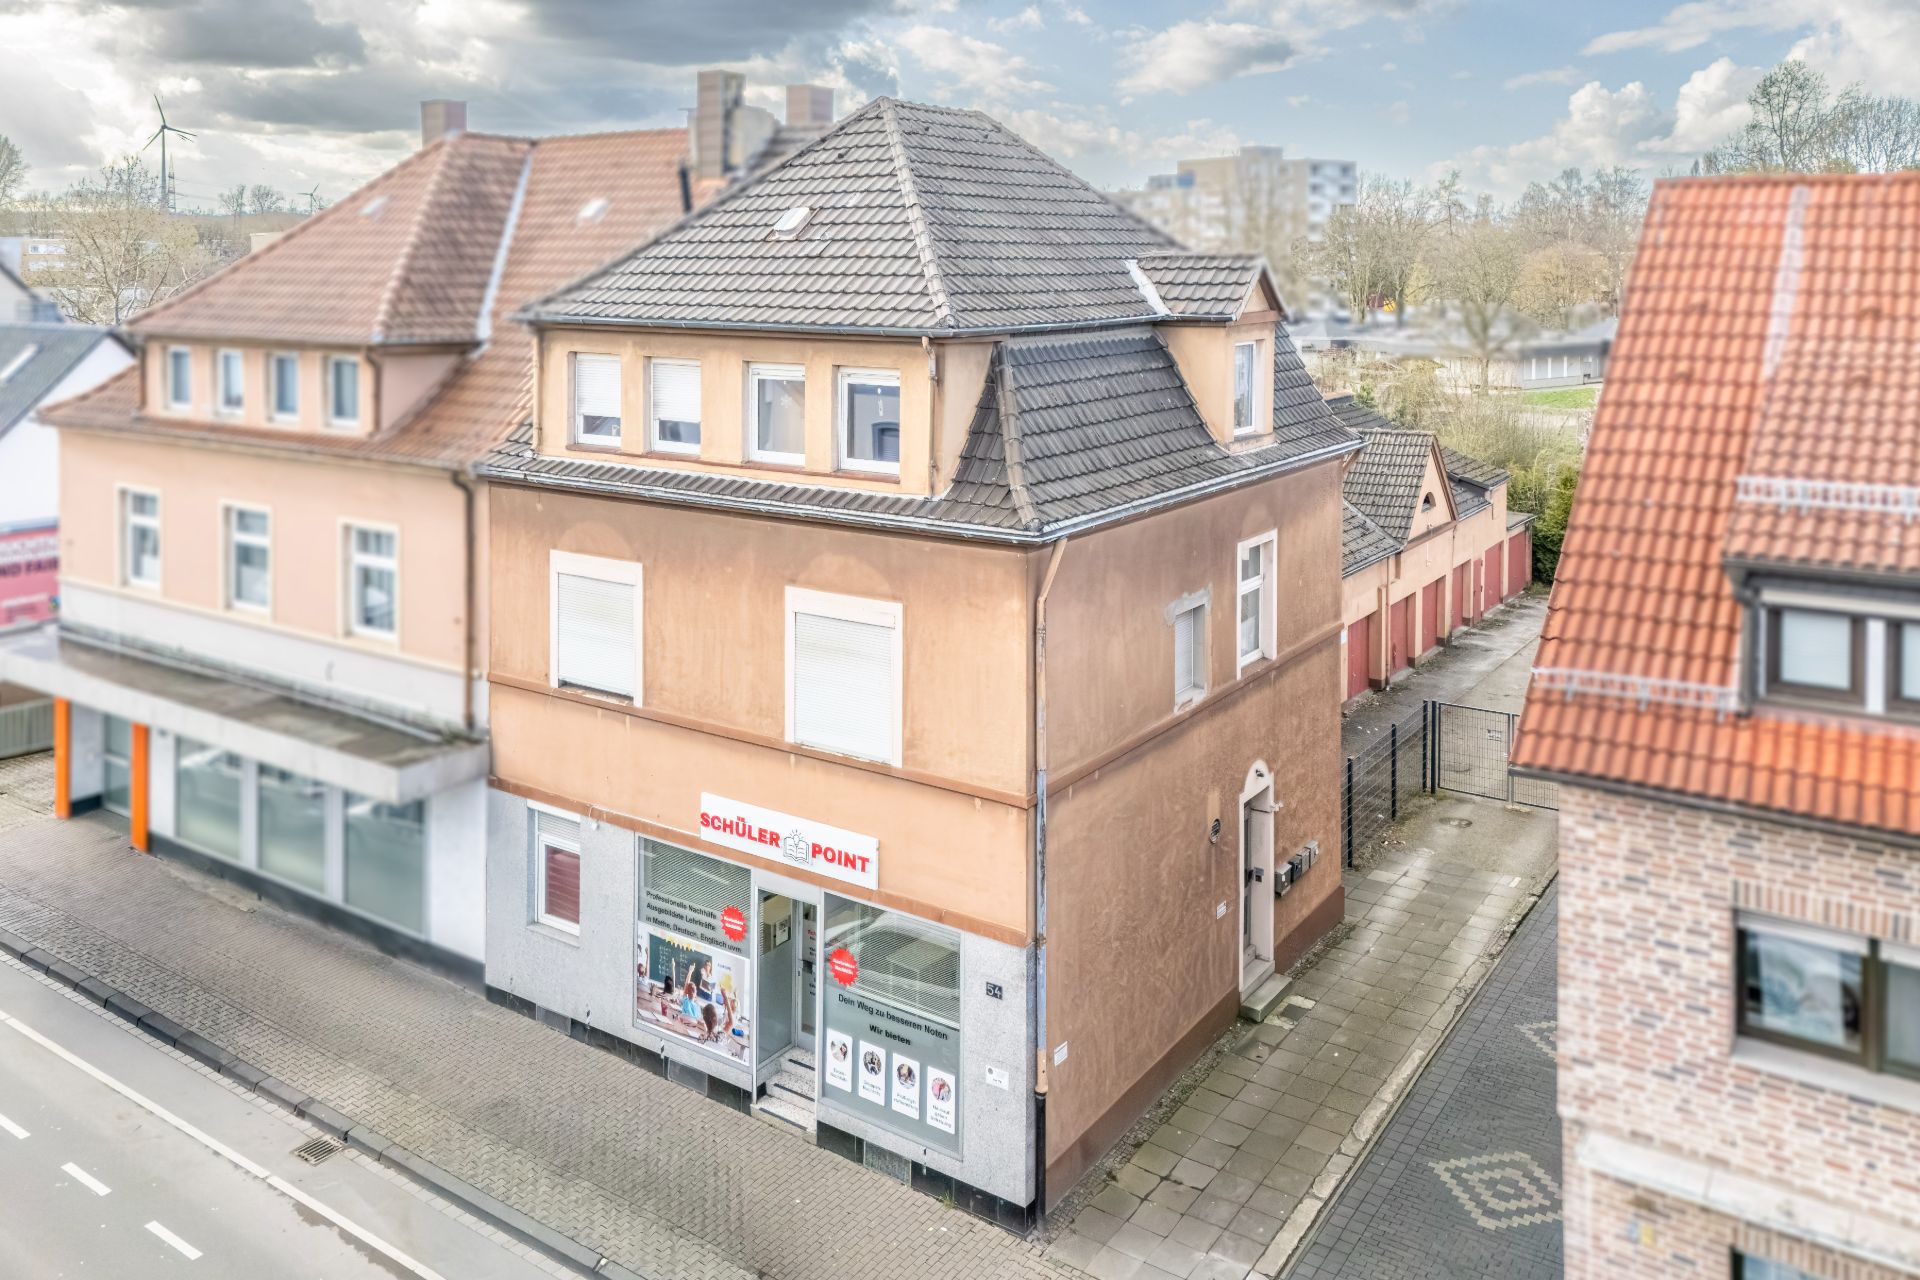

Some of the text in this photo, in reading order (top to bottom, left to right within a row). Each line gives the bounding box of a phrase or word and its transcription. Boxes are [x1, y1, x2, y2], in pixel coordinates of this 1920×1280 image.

[700, 812, 870, 873] SCHÜLER POINT
[646, 890, 717, 920] Professionelle Nachhilfe
[646, 902, 685, 920] Ausgebildete
[685, 914, 716, 931] Lehrkräfte
[700, 932, 727, 949] Englisch
[986, 983, 1002, 999] 54
[838, 993, 948, 1040] Dein Weg zu besseren Noten
[869, 1023, 911, 1046] Wir bieten
